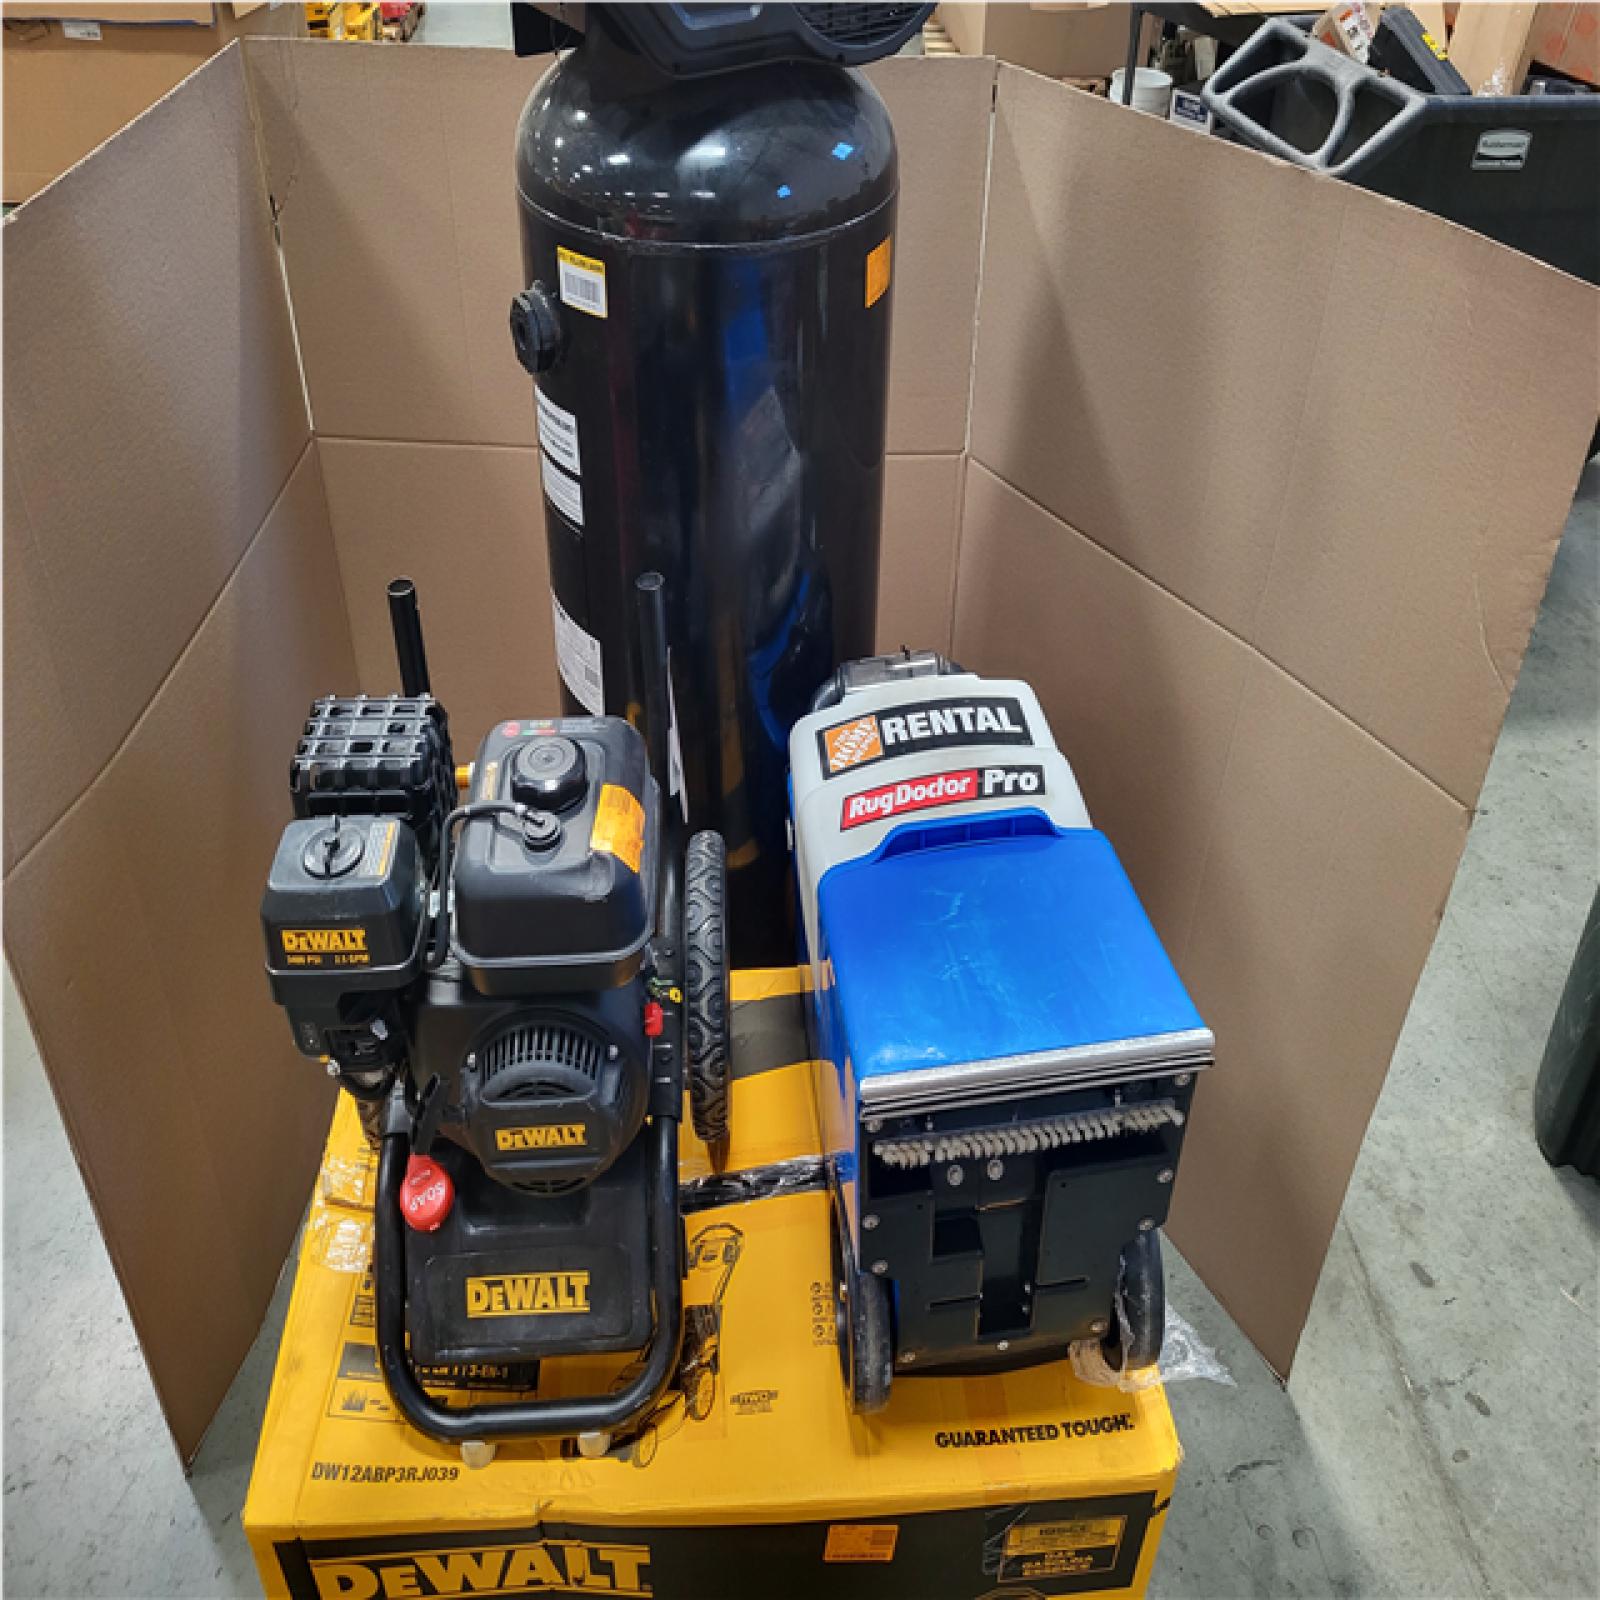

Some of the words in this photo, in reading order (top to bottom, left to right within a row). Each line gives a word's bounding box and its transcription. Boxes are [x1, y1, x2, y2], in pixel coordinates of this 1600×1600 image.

[881, 707, 1022, 745] RENTAL
[849, 774, 972, 817] RugDoctor
[984, 769, 1038, 795] Pro
[496, 1124, 586, 1150] DEWALT
[410, 1182, 445, 1212] SOAP
[468, 1274, 590, 1315] DEWALT
[935, 1424, 1059, 1448] GUARANTEED
[311, 1543, 651, 1600] DEWALT
